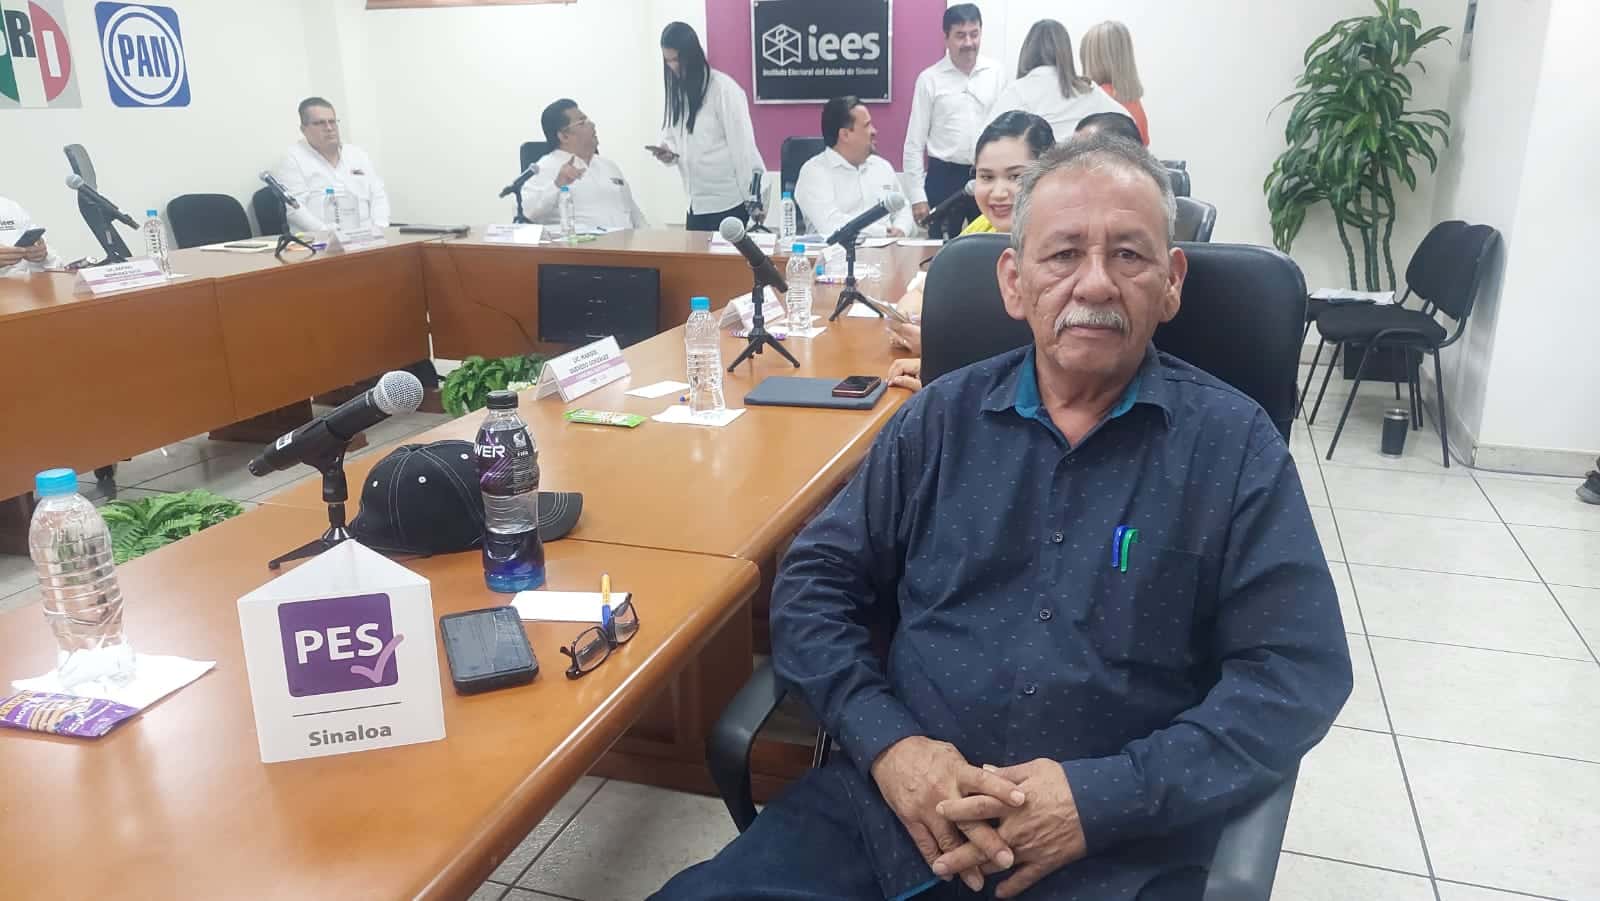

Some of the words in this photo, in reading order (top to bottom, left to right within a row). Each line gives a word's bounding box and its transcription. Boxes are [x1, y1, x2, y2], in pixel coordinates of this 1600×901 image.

[0, 10, 62, 78] RI
[118, 33, 172, 78] PAN
[808, 24, 881, 61] iees
[762, 68, 787, 76] Instituto
[788, 67, 814, 76] Electoral
[815, 68, 824, 76] del
[825, 67, 845, 76] Estado
[856, 67, 879, 76] Sinaloa
[294, 622, 384, 665] PES
[308, 724, 393, 747] Sinaloa
